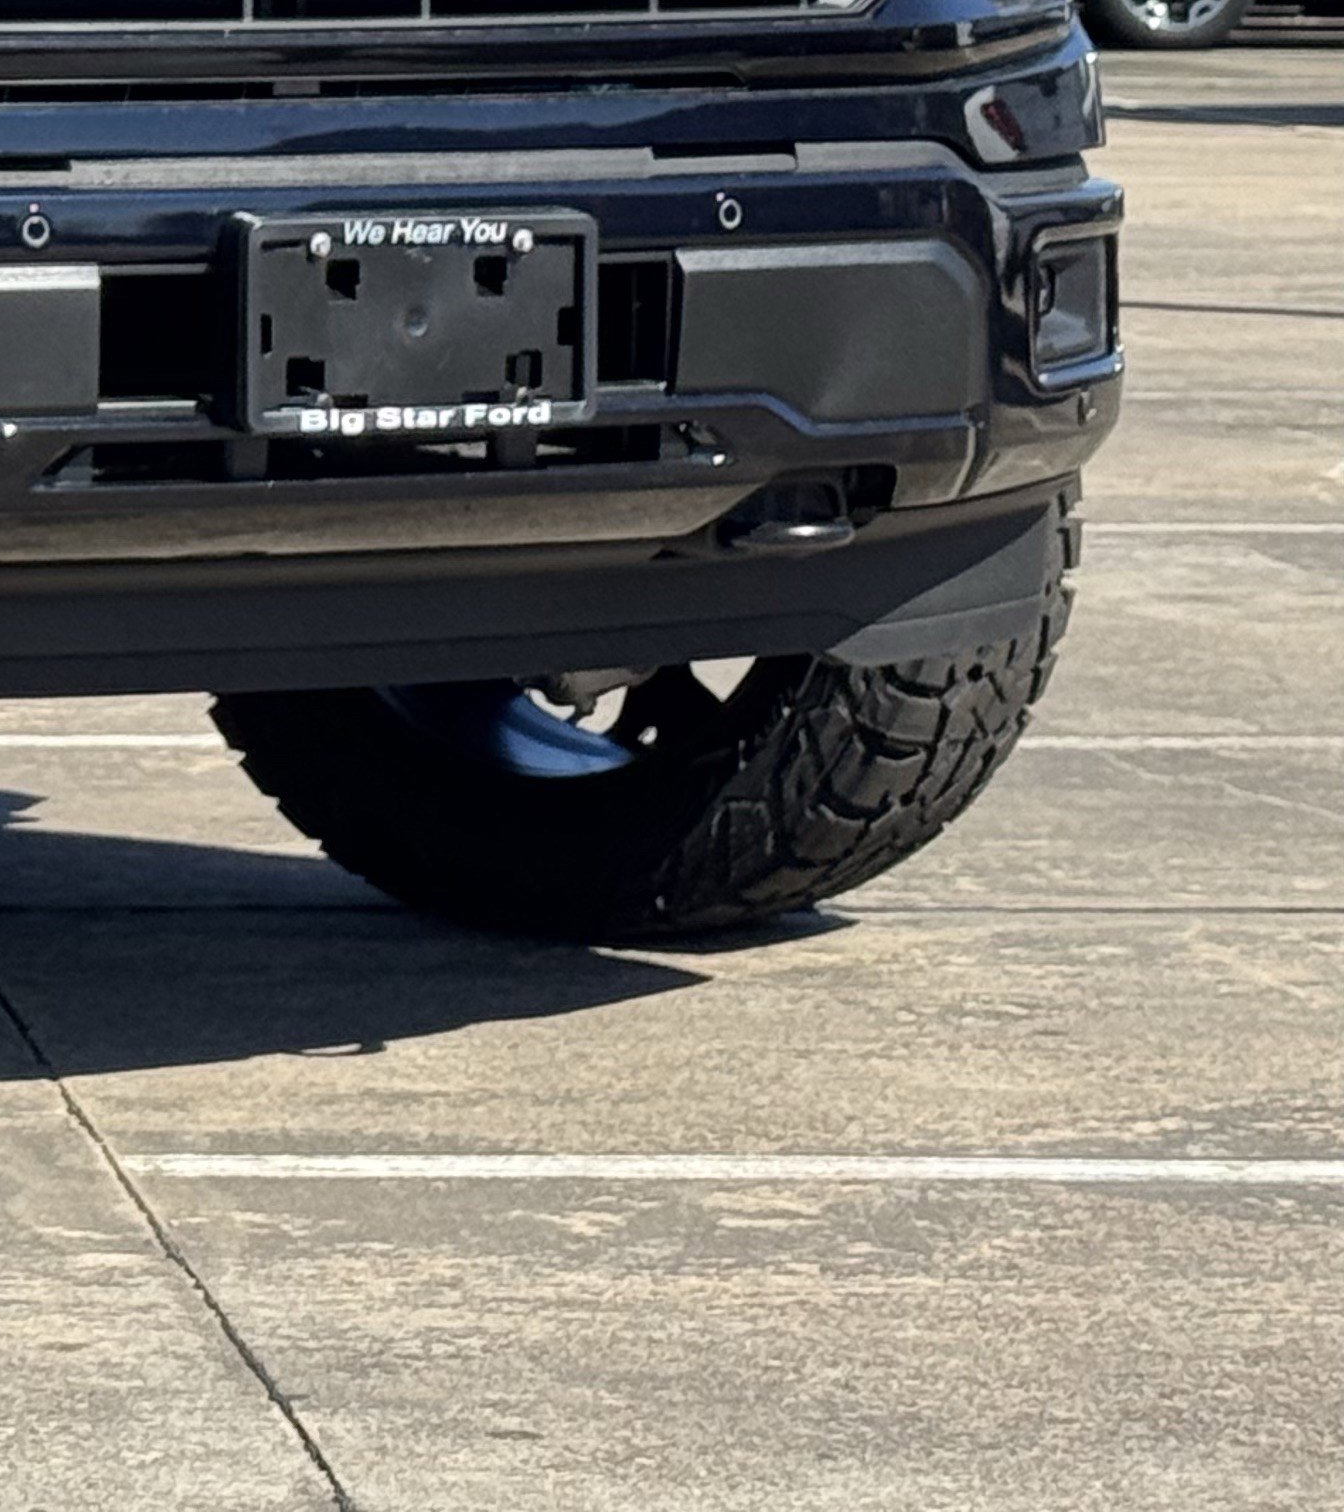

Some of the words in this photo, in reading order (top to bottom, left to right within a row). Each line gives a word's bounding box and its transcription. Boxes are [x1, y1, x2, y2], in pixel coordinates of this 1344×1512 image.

[343, 218, 387, 245] We
[391, 218, 454, 244] Hear
[458, 216, 508, 244] You
[299, 408, 366, 435] Big
[376, 405, 454, 429] Star
[464, 400, 552, 428] Ford
